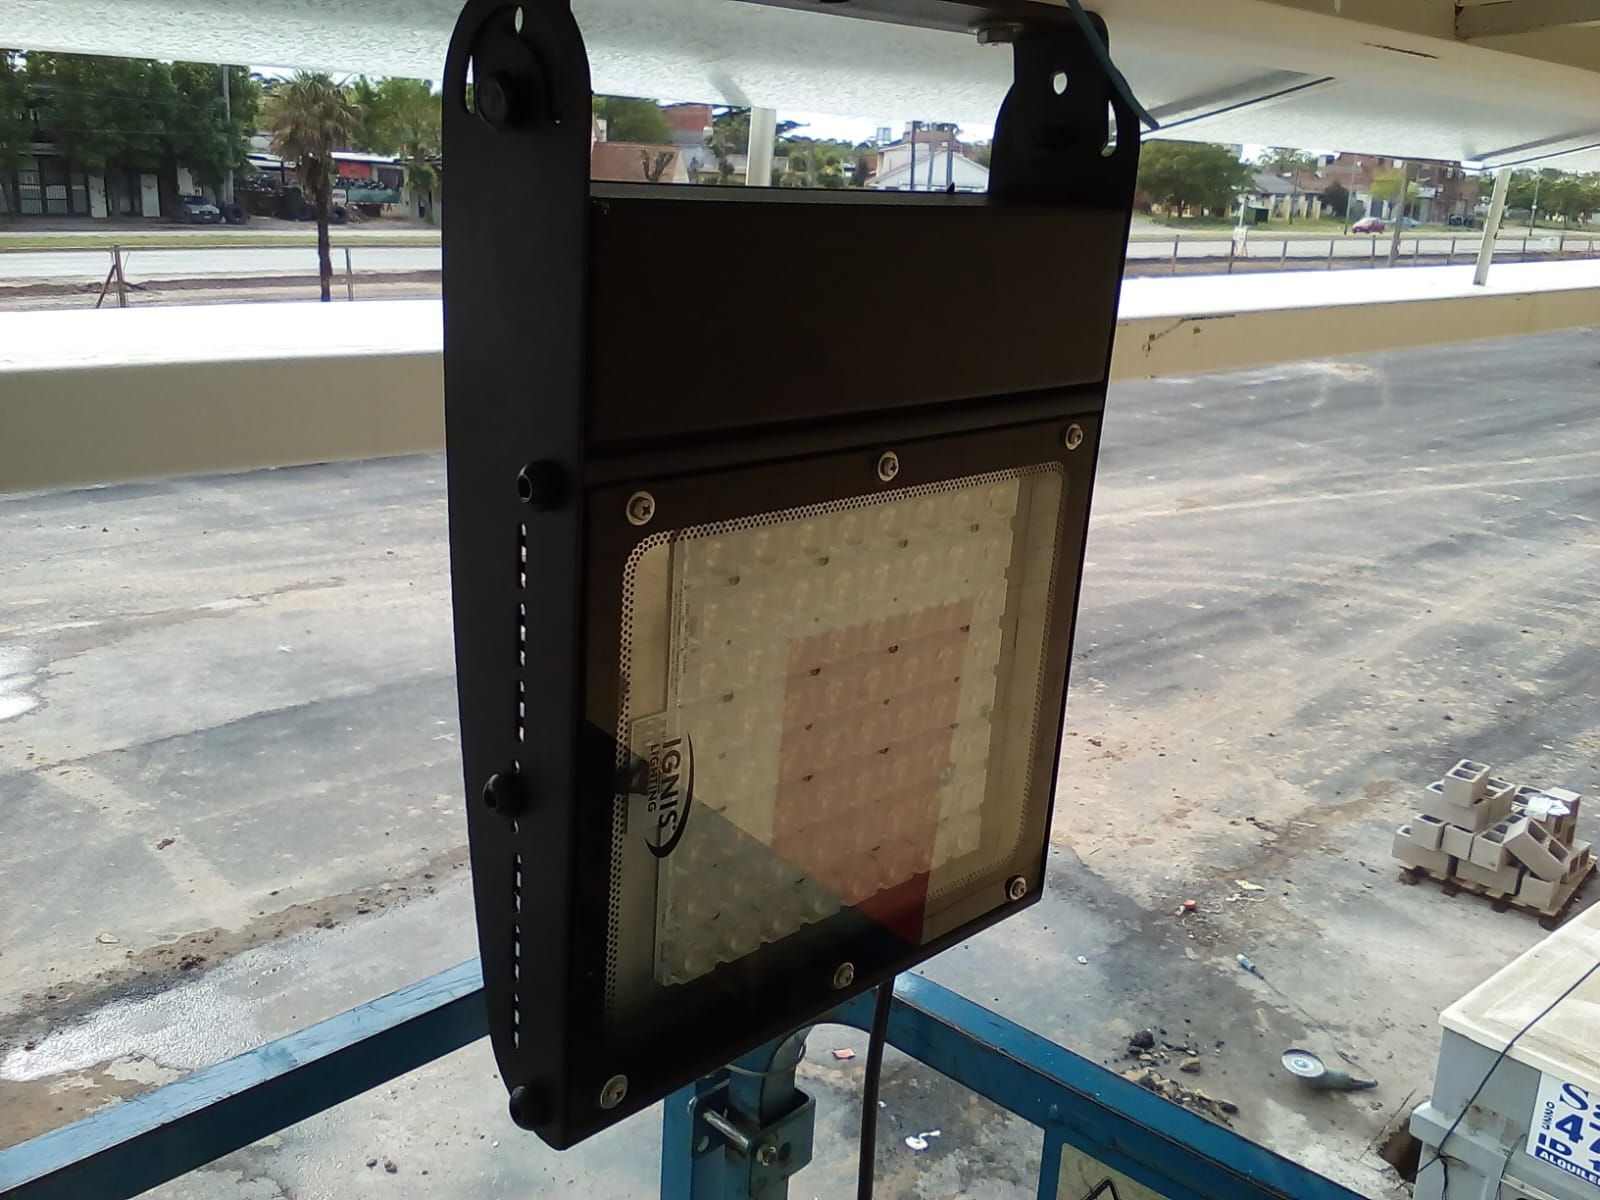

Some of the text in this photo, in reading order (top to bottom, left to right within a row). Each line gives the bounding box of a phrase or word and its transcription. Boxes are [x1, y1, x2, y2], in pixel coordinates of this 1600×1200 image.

[647, 743, 660, 813] LIGHTING
[659, 738, 682, 829] IGNIS
[1559, 1083, 1600, 1119] S
[1538, 1132, 1572, 1157] ID
